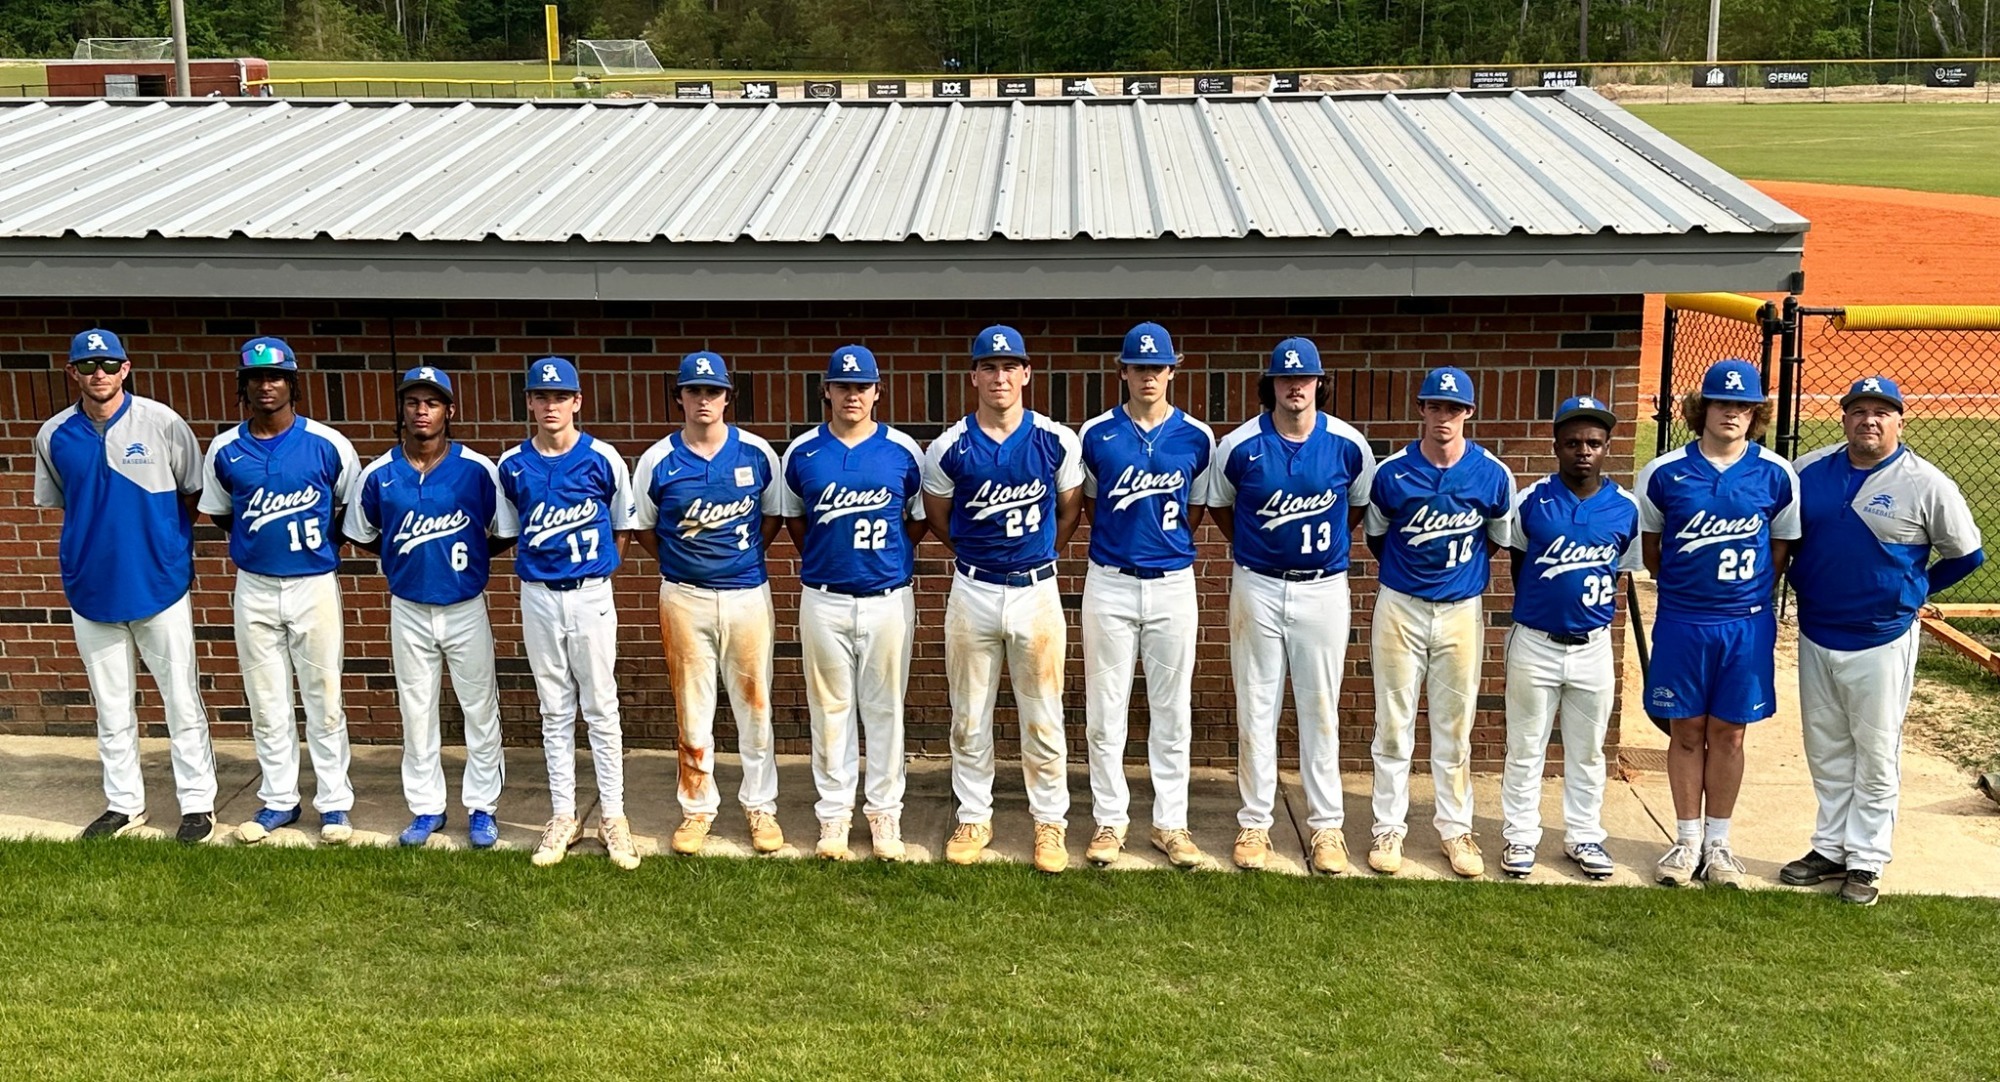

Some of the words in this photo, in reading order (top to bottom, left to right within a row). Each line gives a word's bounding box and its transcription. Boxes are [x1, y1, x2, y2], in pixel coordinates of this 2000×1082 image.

[942, 82, 961, 94] DOE
[1543, 79, 1577, 87] AARON
[813, 481, 892, 513] Lions
[964, 479, 1047, 510] Lions
[1107, 464, 1185, 503] Lions
[241, 485, 321, 522] Lions
[524, 498, 599, 534] Lions
[676, 495, 754, 528] Lions
[1162, 501, 1180, 531] 2
[1256, 488, 1337, 517] Lions
[1863, 506, 1895, 519] BASEBALL
[287, 518, 322, 552] 15
[394, 509, 469, 543] Lions
[853, 519, 888, 550] 22
[1005, 504, 1042, 537] 24
[1400, 505, 1483, 533] Lions
[1675, 510, 1763, 541] Lions
[566, 528, 599, 564] 17
[1300, 521, 1332, 554] 13
[1535, 535, 1615, 565] Lions
[450, 542, 469, 572] 6
[1717, 548, 1756, 581] 23
[1582, 575, 1613, 607] 32
